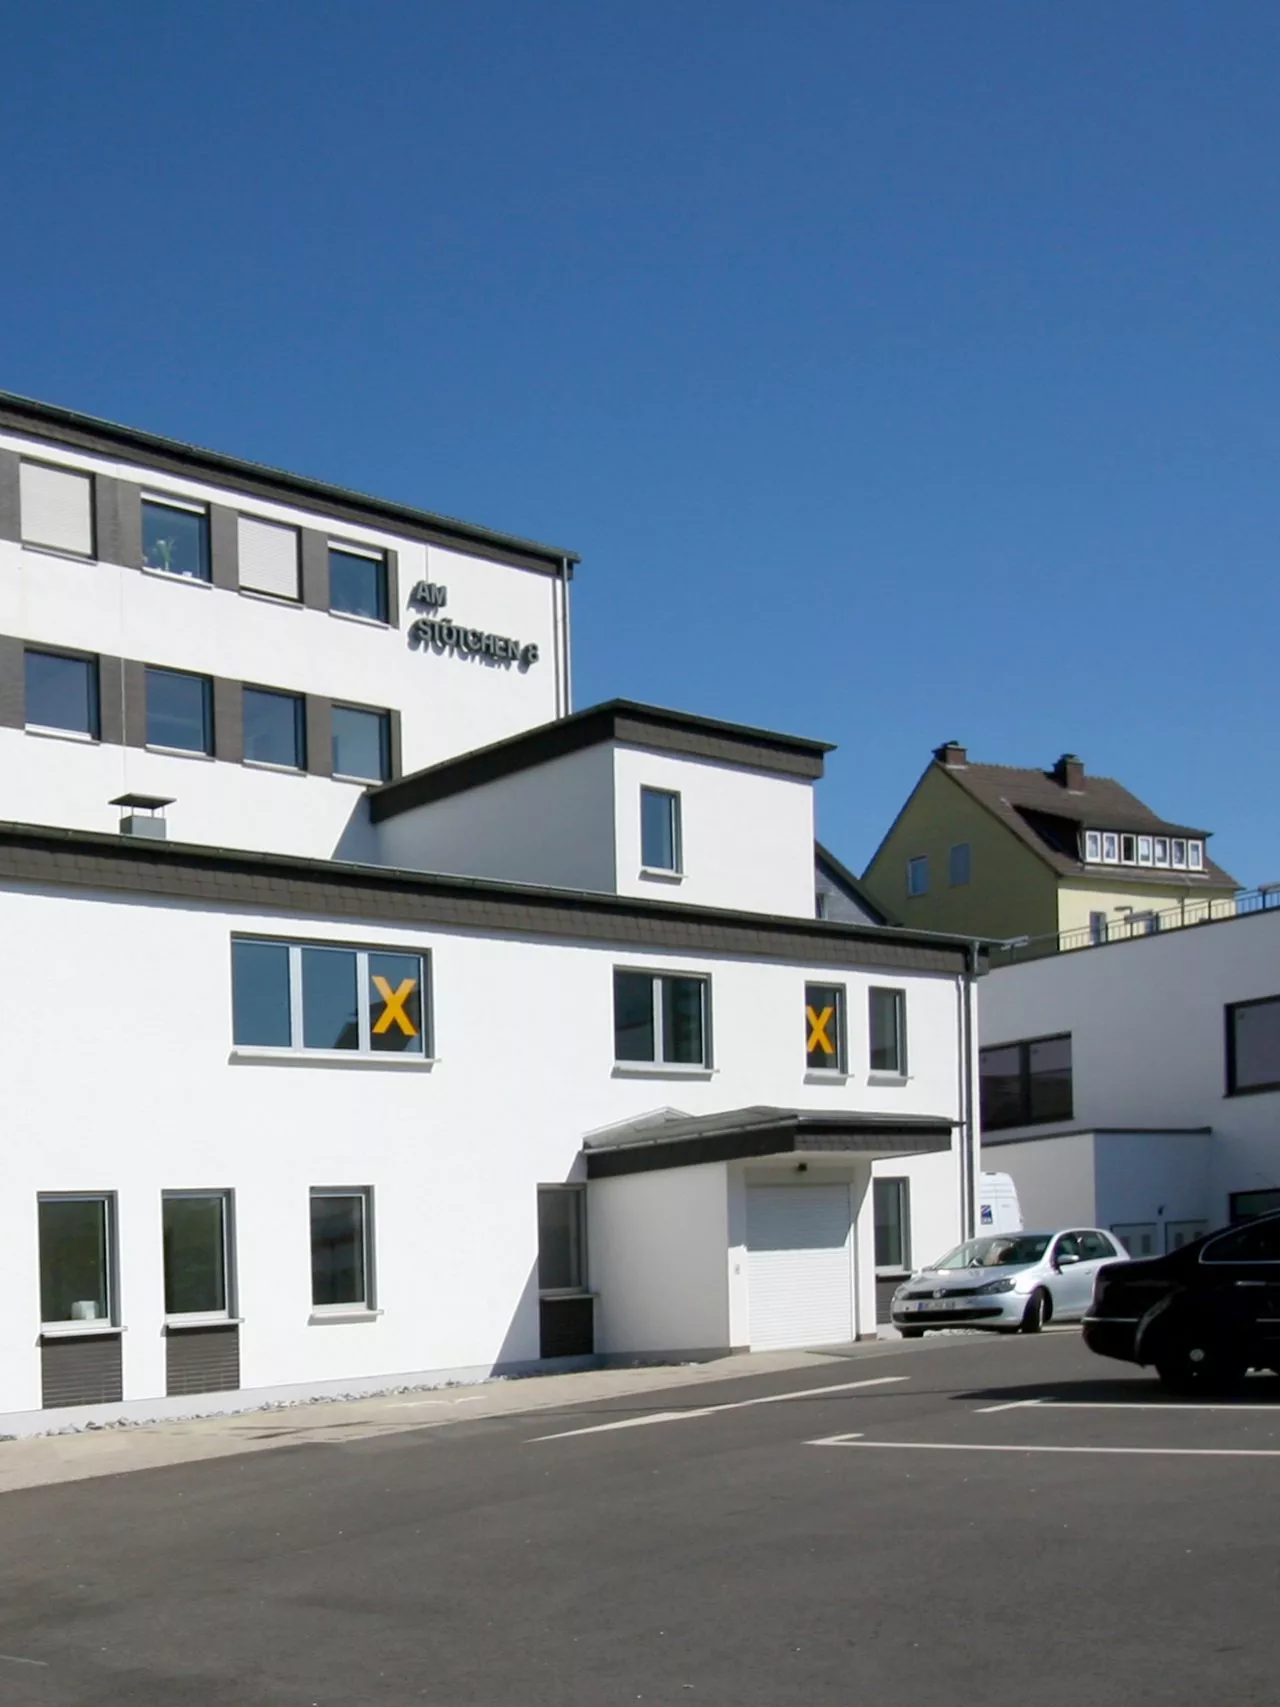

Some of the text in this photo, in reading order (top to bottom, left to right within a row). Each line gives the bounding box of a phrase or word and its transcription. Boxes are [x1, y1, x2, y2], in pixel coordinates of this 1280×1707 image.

[415, 580, 447, 608] AM
[371, 975, 418, 1037] X
[806, 1005, 835, 1054] X
